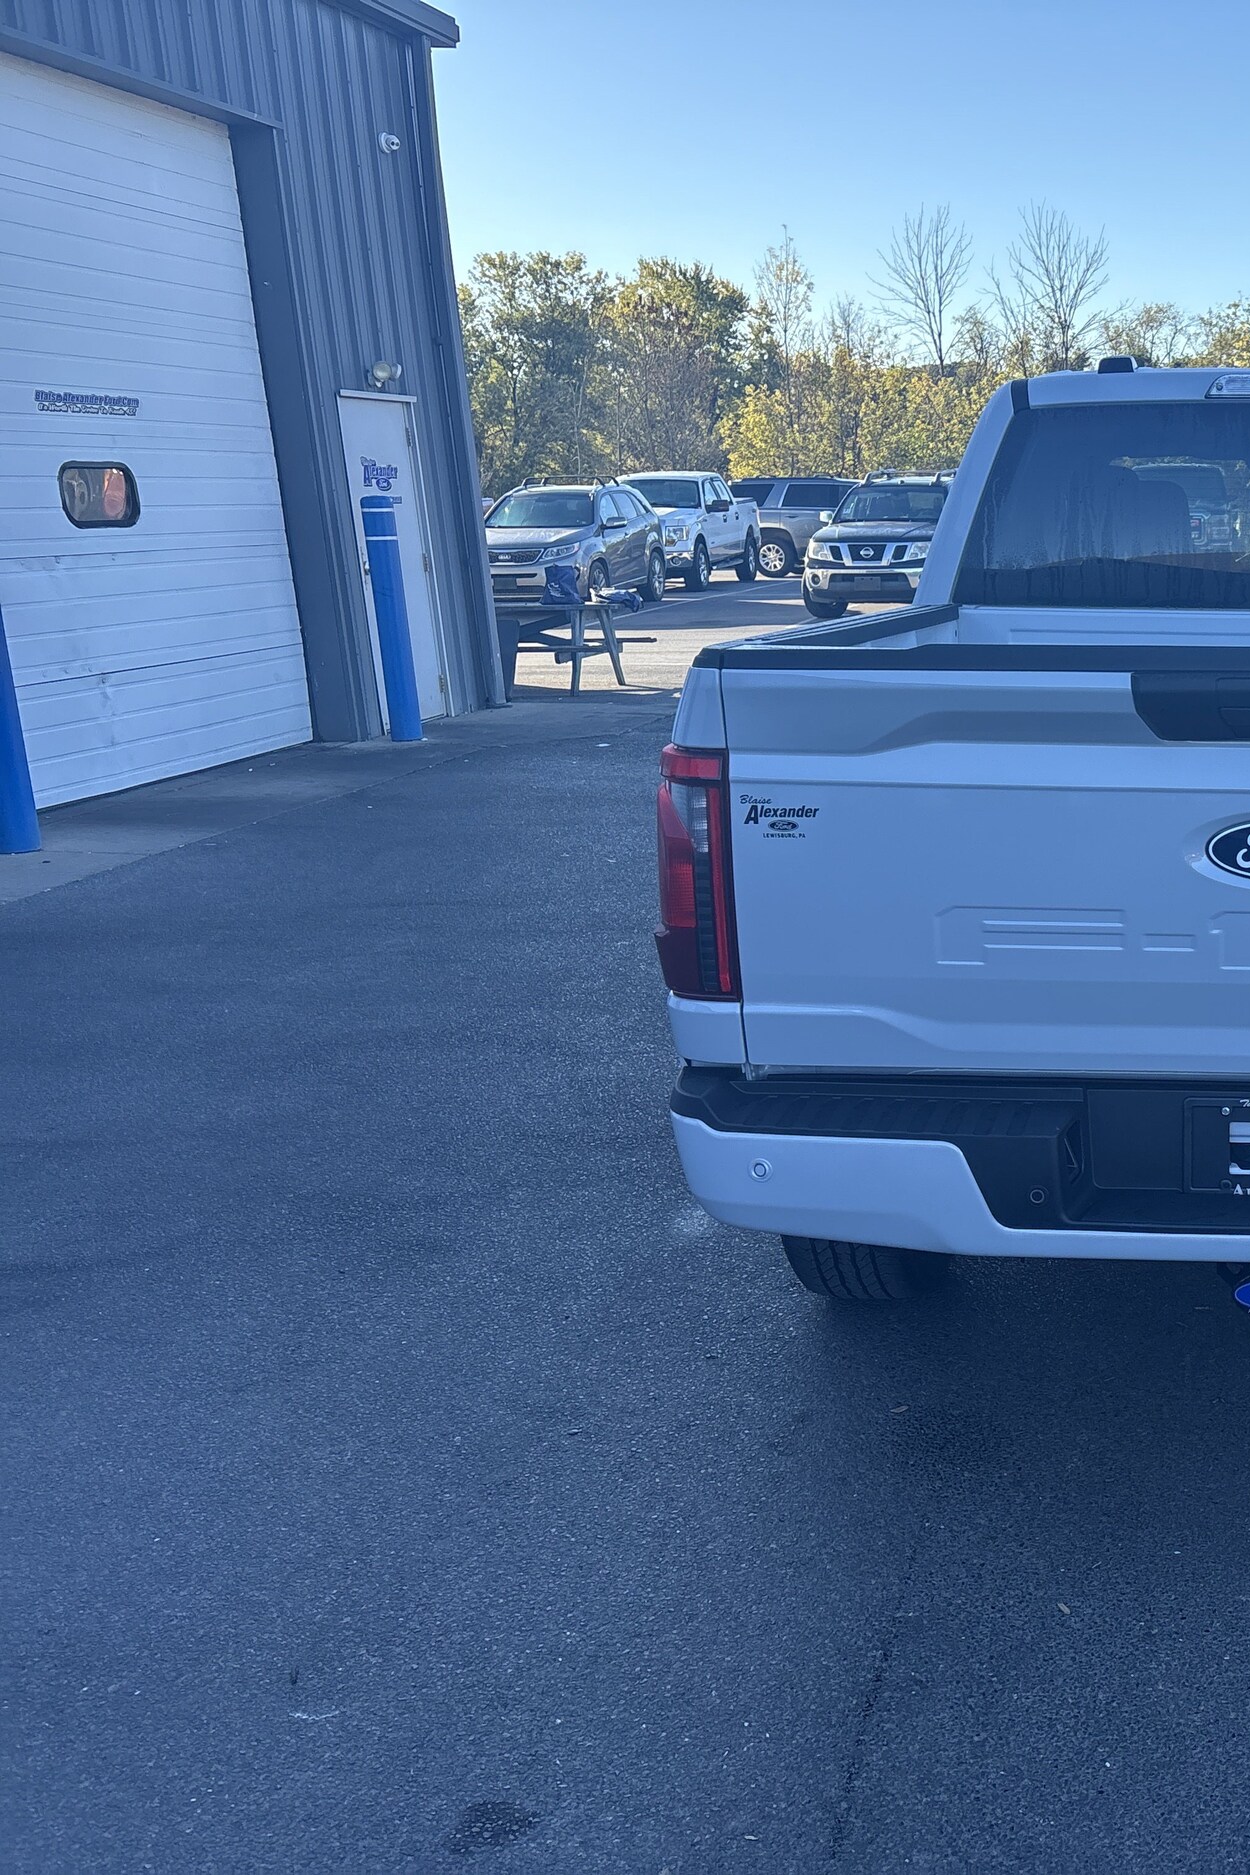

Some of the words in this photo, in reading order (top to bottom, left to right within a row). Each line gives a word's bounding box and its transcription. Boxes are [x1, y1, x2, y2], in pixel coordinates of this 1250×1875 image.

[363, 464, 398, 487] Alexander
[740, 794, 772, 804] Blaise
[743, 805, 820, 825] Alexander
